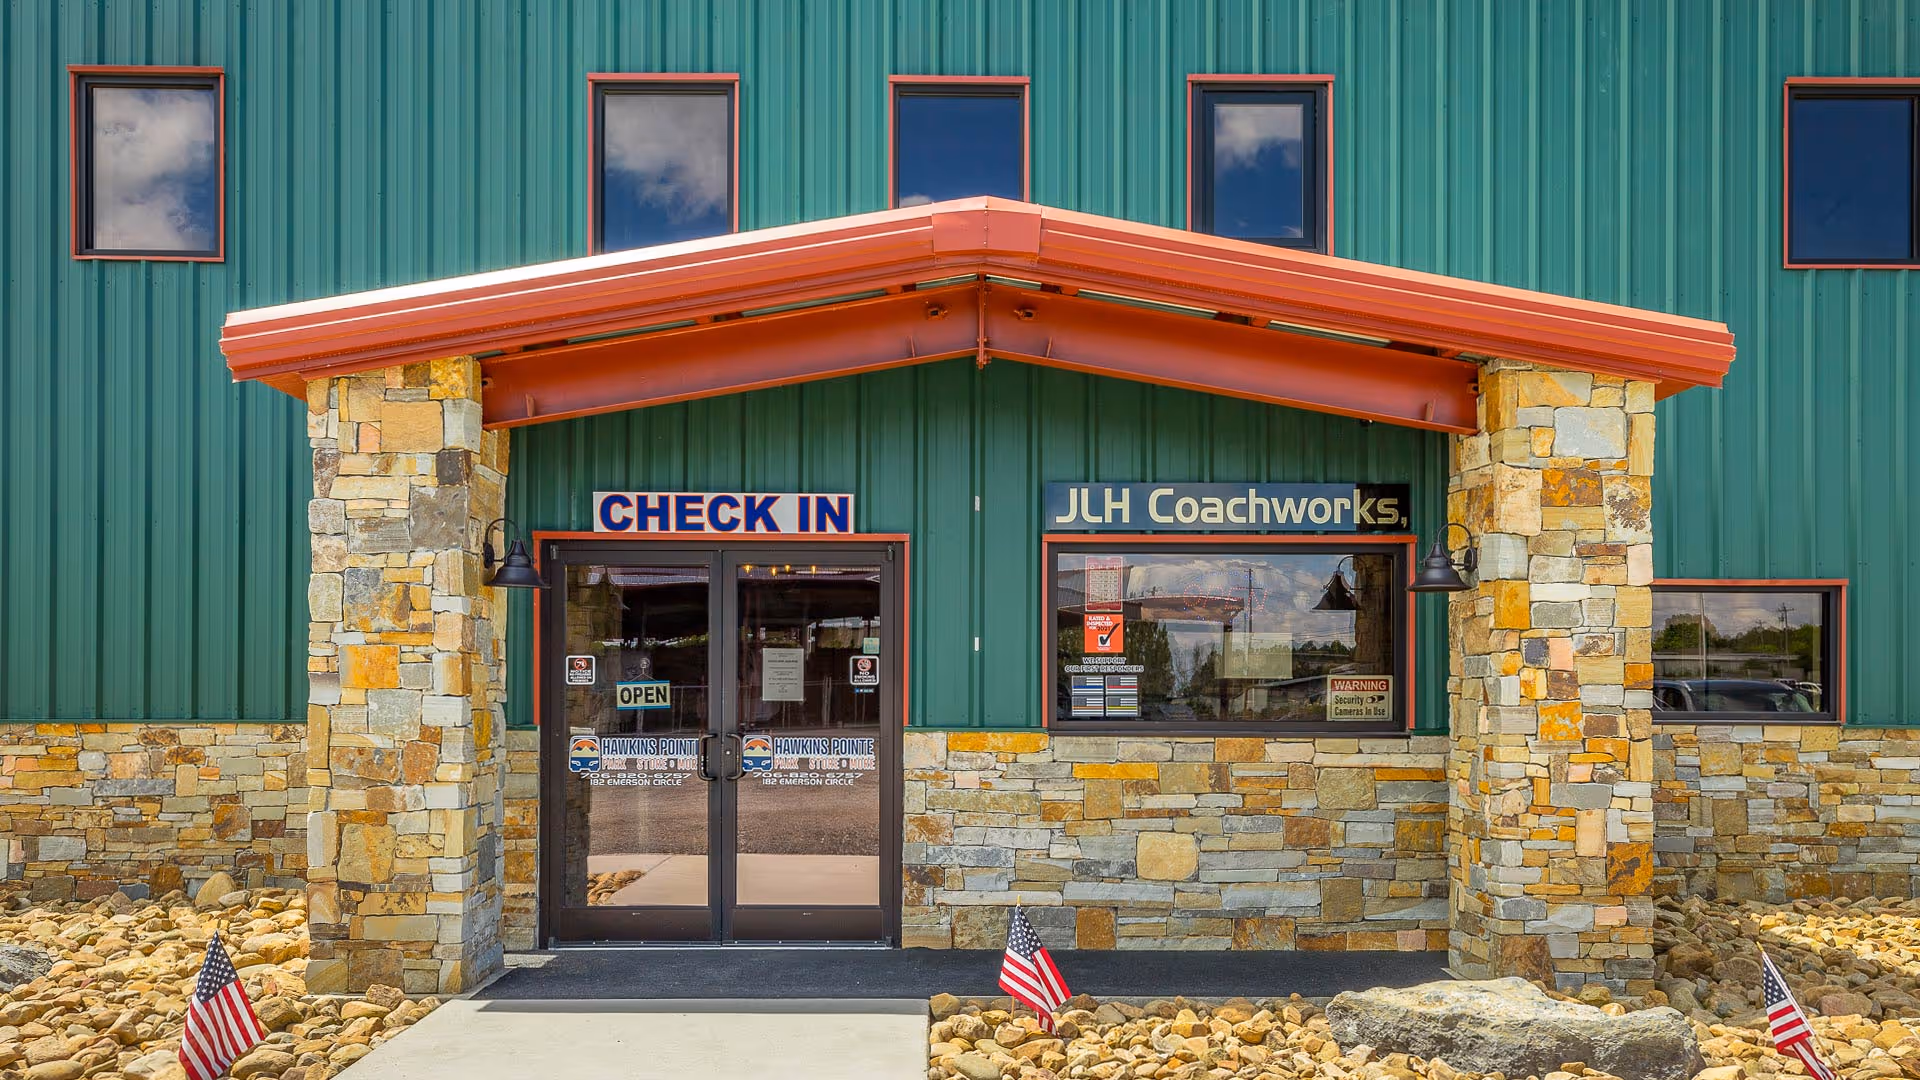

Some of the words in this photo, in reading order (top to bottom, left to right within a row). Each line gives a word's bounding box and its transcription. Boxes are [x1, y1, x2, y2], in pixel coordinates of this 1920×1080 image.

[598, 494, 782, 532] CHECK
[797, 495, 850, 533] IN
[1055, 488, 1130, 523] JLH
[1148, 488, 1408, 527] Coachworks,
[1184, 583, 1269, 611] OPEN
[1334, 681, 1386, 690] WARNING
[620, 686, 667, 704] OPEN
[1335, 695, 1364, 705] Security
[1335, 707, 1363, 716] Cameras
[1365, 707, 1372, 716] In
[1373, 707, 1386, 716] Use
[601, 738, 657, 756] HAWKINS
[774, 738, 829, 756] HAWKINS
[832, 738, 874, 756] POINTE
[602, 757, 627, 770] PARK
[636, 757, 668, 770] STORE
[774, 757, 799, 770] PARK
[809, 757, 840, 770] STORE
[849, 757, 875, 770] MORE
[590, 778, 605, 786] 182
[607, 778, 650, 786] EMERSON
[653, 778, 682, 786] CIRCLE
[762, 778, 777, 786] 182
[779, 778, 823, 786] EMERSON
[825, 778, 854, 786] CIRCLE
